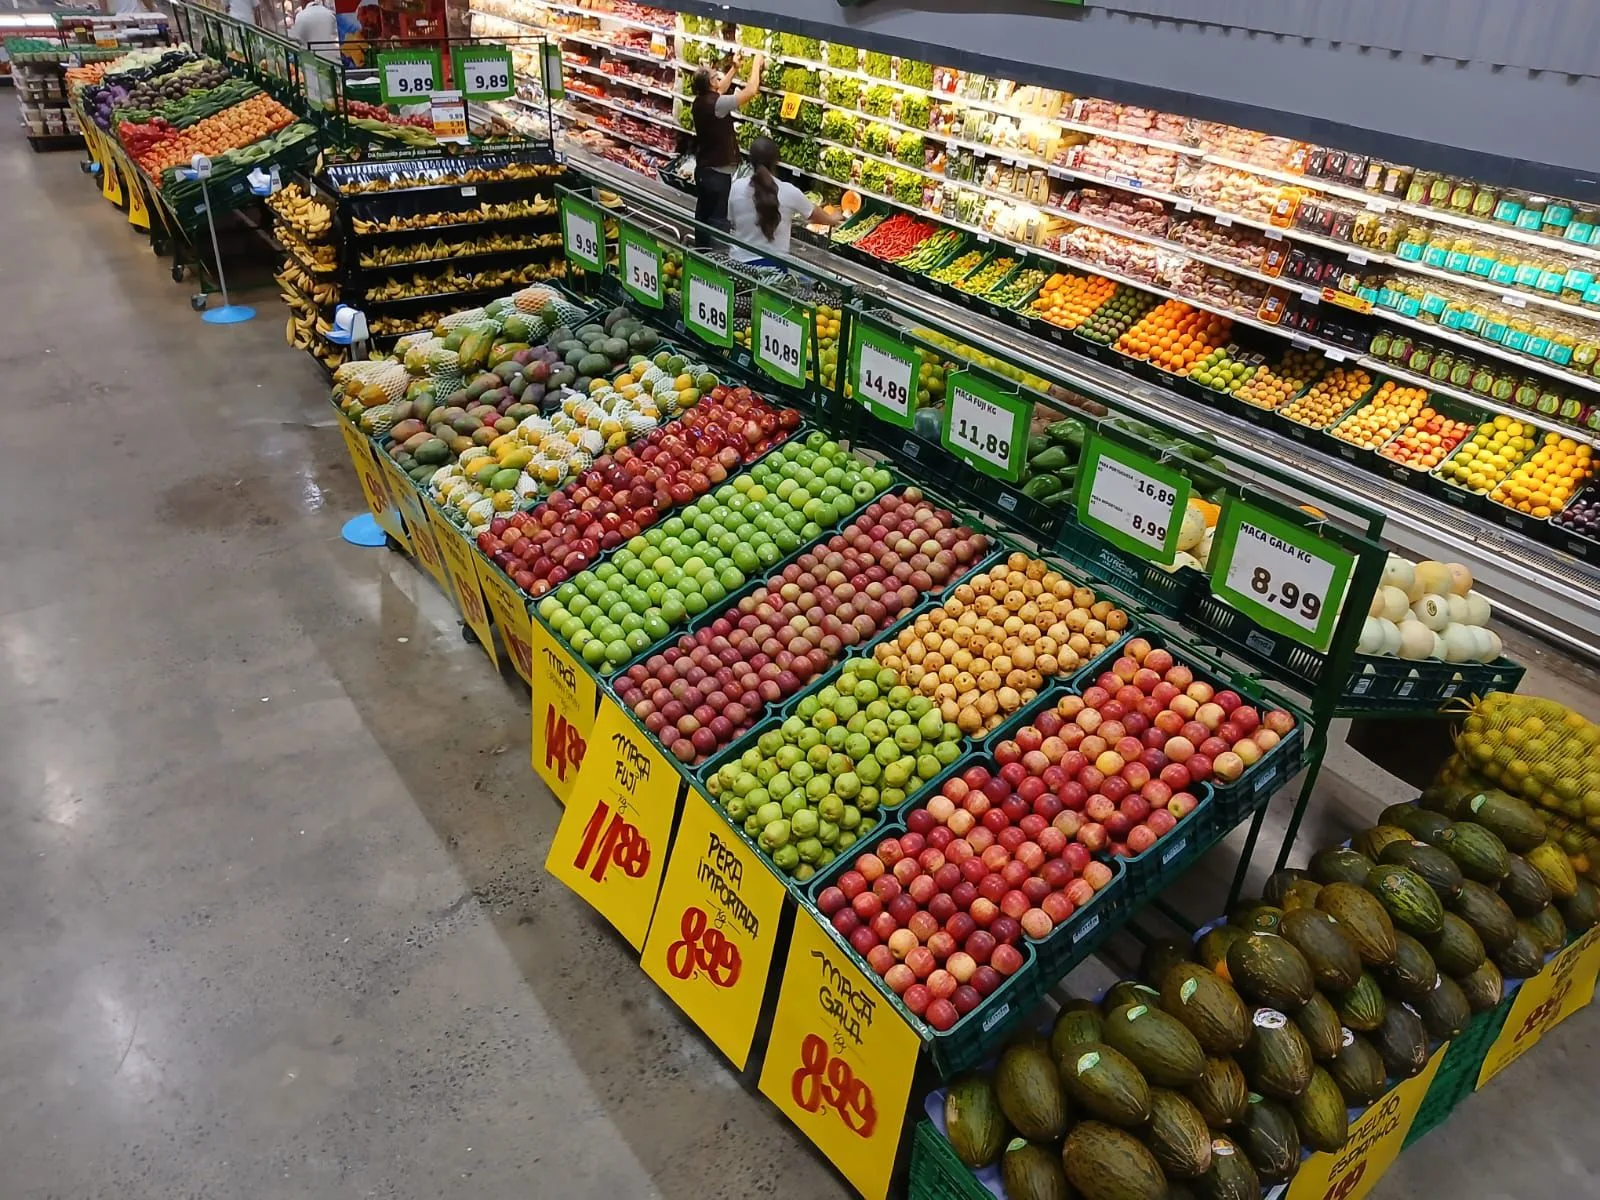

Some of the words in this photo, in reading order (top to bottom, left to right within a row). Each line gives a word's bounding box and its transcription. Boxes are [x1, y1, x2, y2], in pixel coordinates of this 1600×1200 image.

[398, 77, 434, 93] 9,89
[475, 74, 508, 90] 9,89
[576, 234, 598, 258] 9,99
[633, 266, 657, 292] 5,99
[698, 302, 726, 330] 6,89
[764, 335, 799, 366] 10,89
[865, 369, 907, 405] 14,89
[955, 388, 973, 404] MACA
[973, 398, 987, 411] FUJI
[987, 405, 997, 415] KG
[958, 419, 1010, 460] 11,89
[1137, 480, 1176, 506] 16,89
[1132, 514, 1167, 542] 8,99
[1240, 522, 1267, 543] MACA
[1269, 537, 1295, 556] GALA
[1296, 549, 1312, 564] KG
[1251, 566, 1321, 620] 8,99
[666, 906, 743, 989] 8,99
[819, 986, 864, 1046] GALA
[791, 1033, 879, 1139] 8,99
